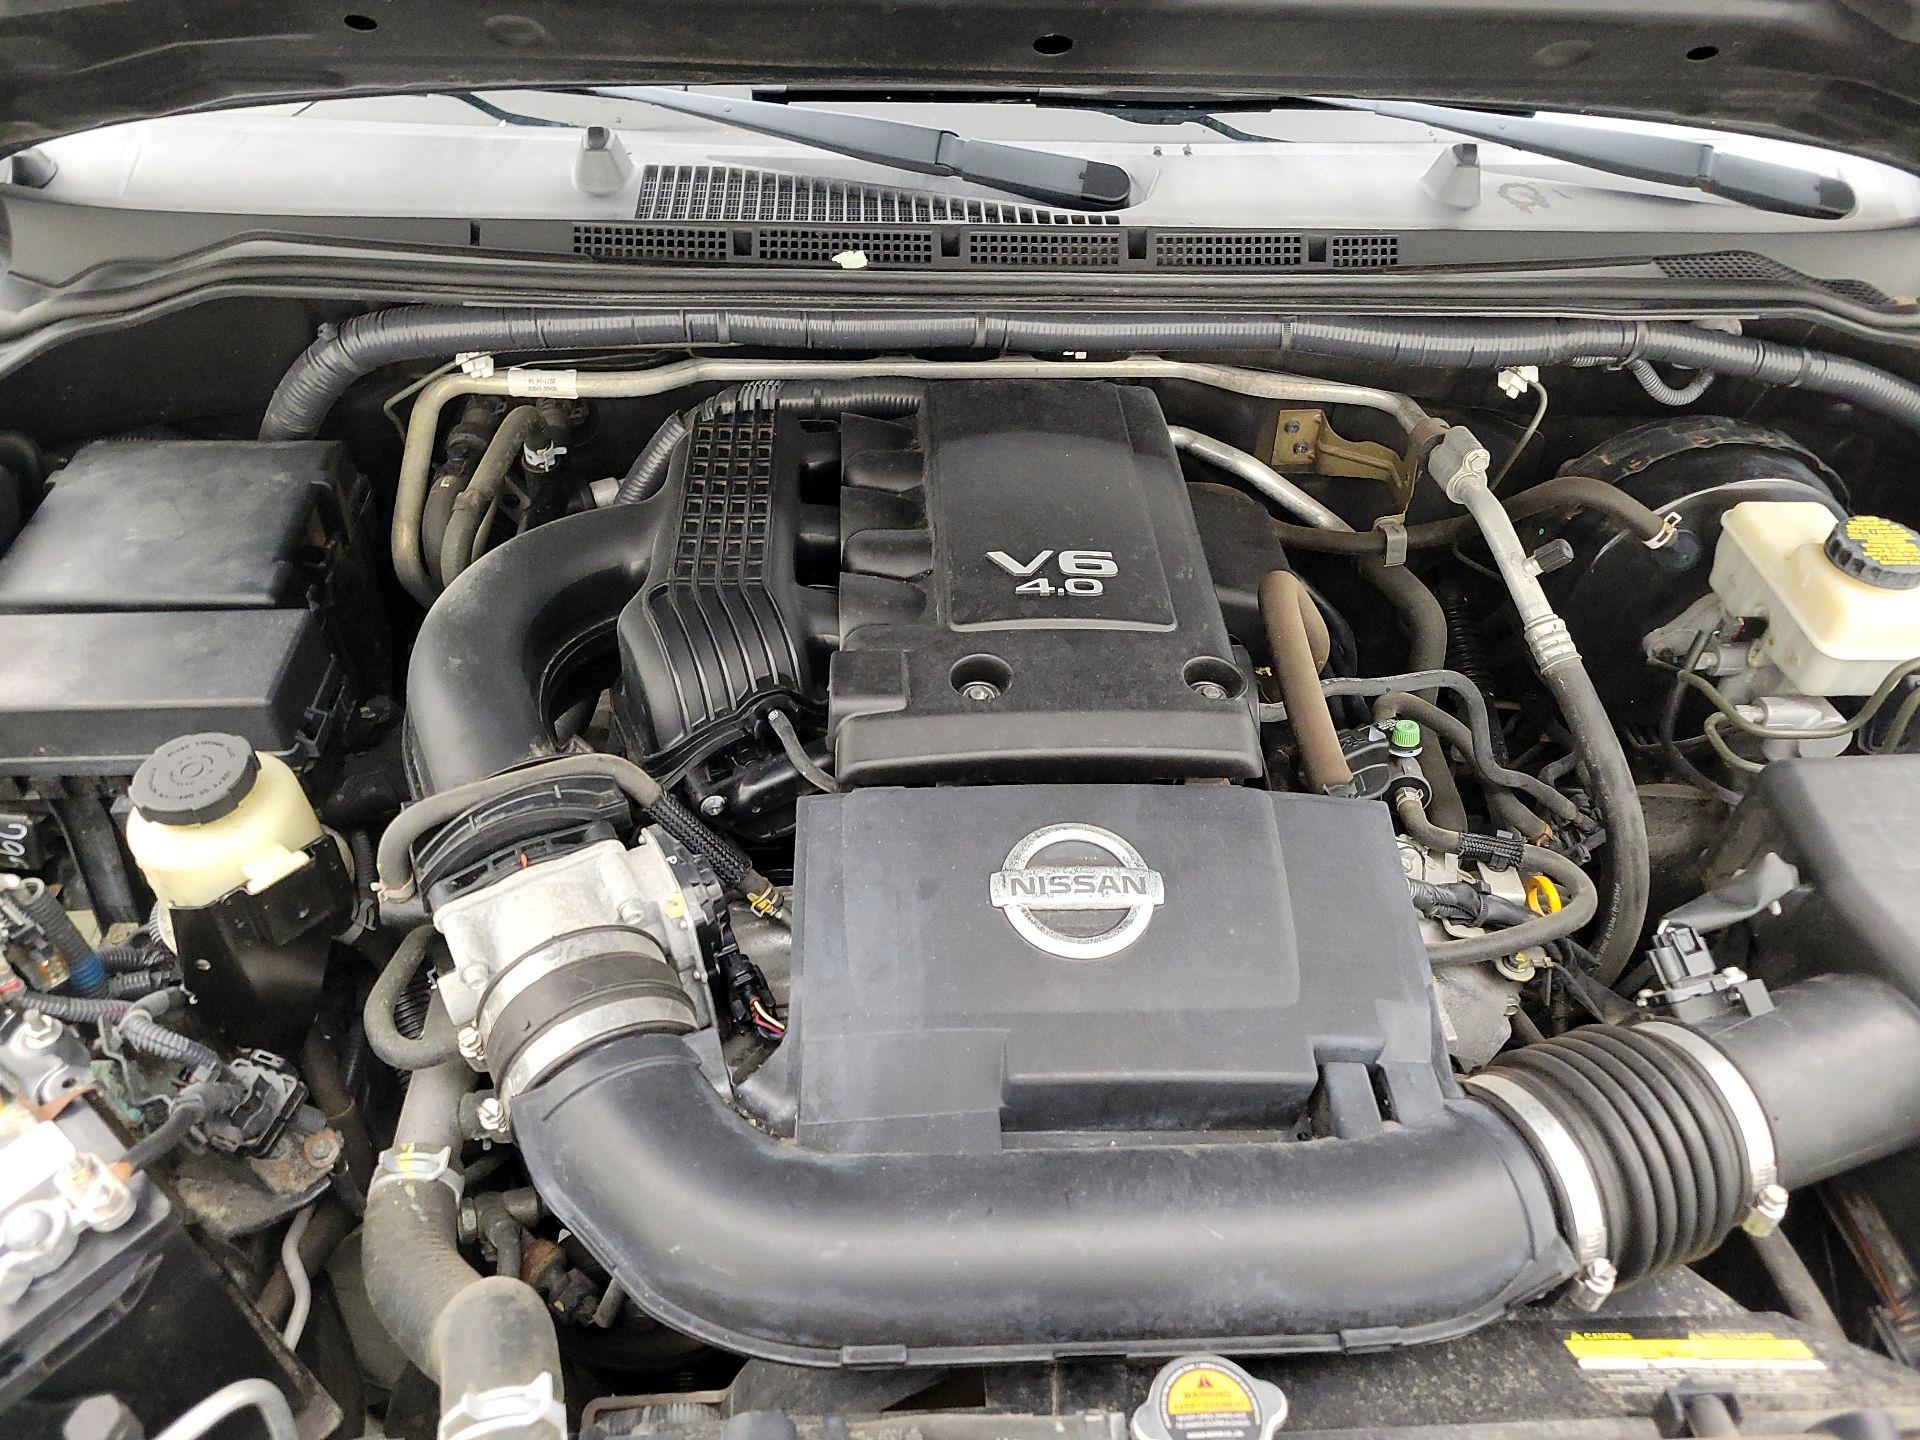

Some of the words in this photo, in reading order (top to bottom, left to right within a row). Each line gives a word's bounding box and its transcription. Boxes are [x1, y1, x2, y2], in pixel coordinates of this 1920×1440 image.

[985, 550, 1118, 577] V6
[1015, 578, 1103, 596] 4.0
[1010, 875, 1147, 896] NISSAN
